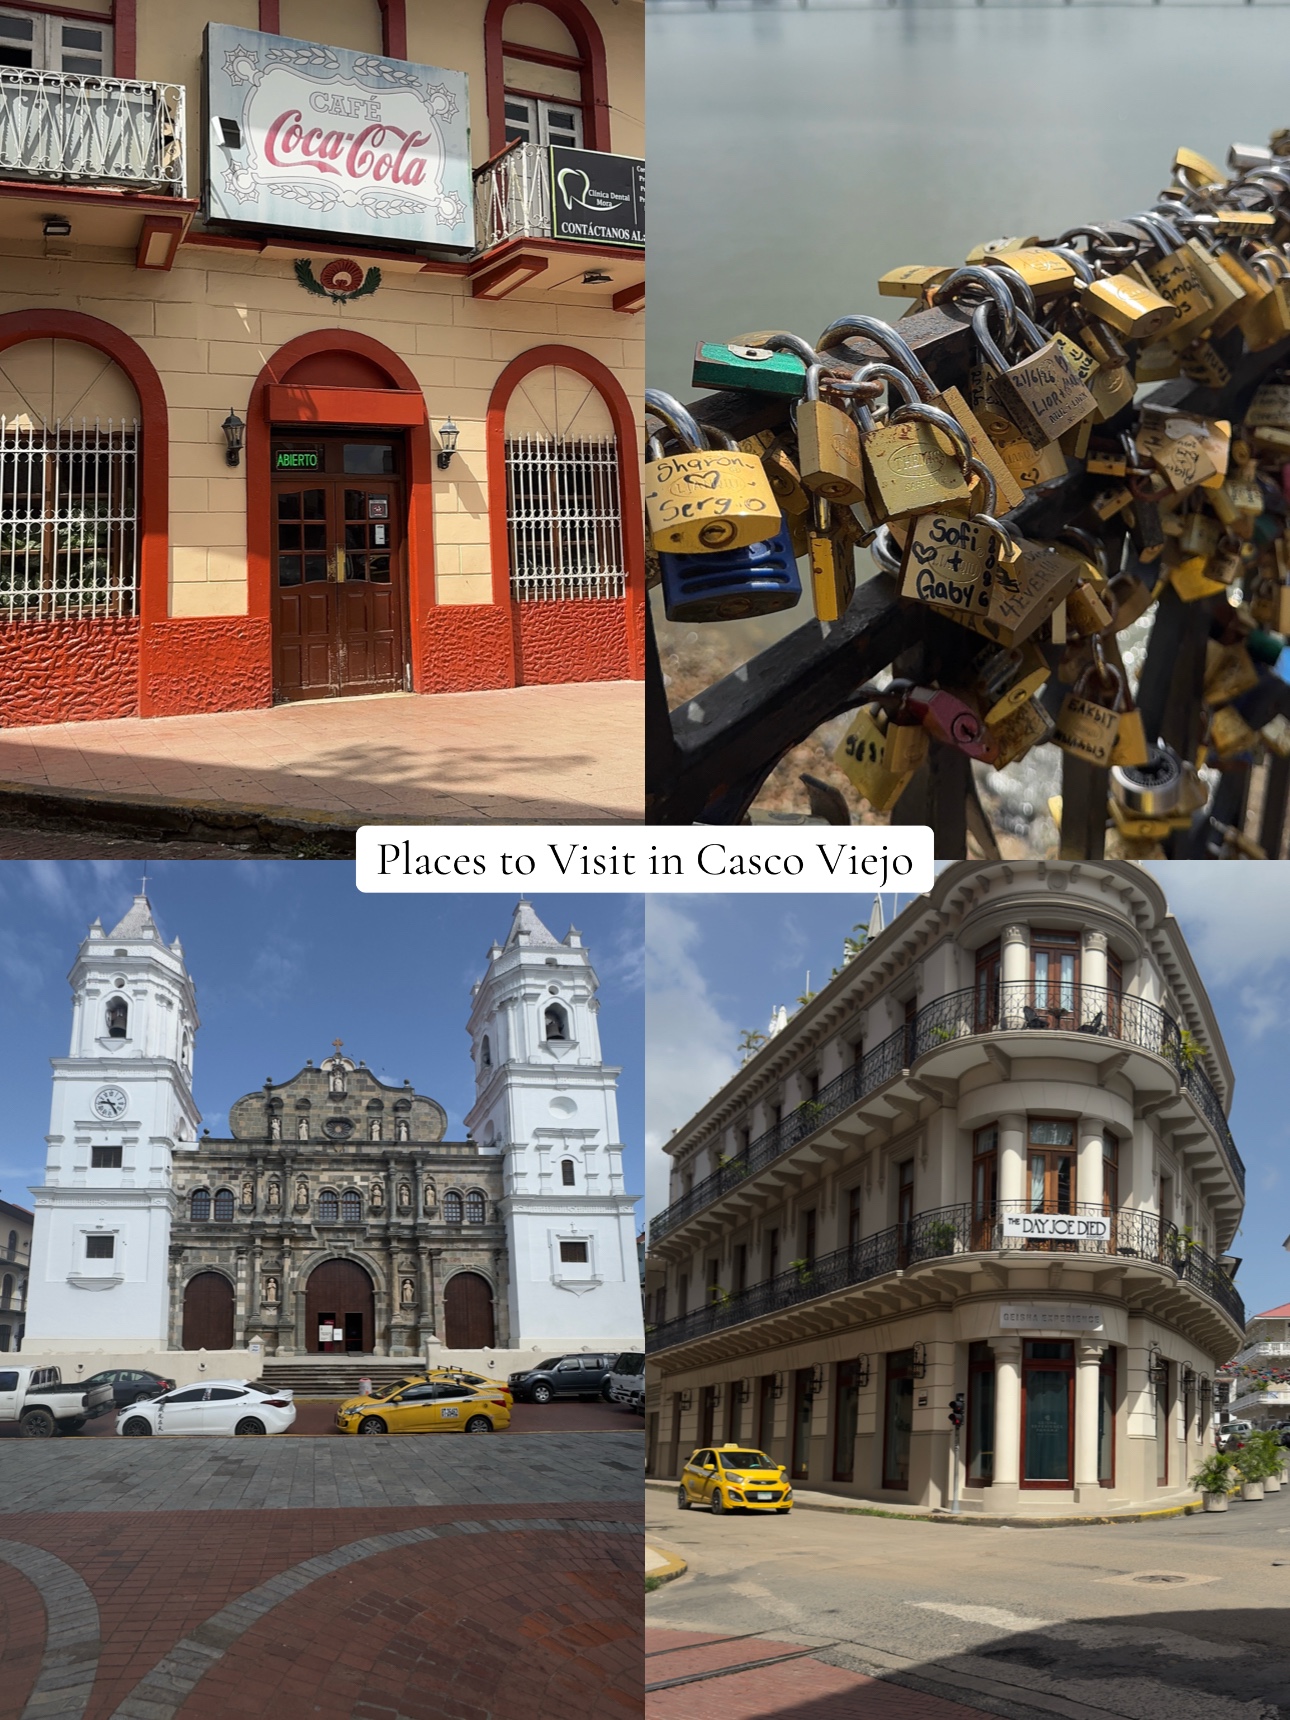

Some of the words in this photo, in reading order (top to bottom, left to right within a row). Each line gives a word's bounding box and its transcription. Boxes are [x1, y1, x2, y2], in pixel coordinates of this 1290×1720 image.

[309, 91, 382, 122] CAFÉ
[264, 109, 432, 187] Coca-Cola
[588, 189, 610, 199] Clínica
[610, 192, 631, 202] Dental
[596, 199, 613, 207] Mora
[561, 222, 630, 240] CONTÁCTANOS
[277, 453, 318, 467] ABIERTO
[657, 456, 744, 483] Sharon
[929, 518, 979, 551] Sofi
[916, 568, 974, 608] Gaby
[1007, 1217, 1021, 1226] THE
[1022, 1218, 1049, 1234] DAY
[1048, 1219, 1075, 1235] JOE
[1077, 1220, 1107, 1236] DIED
[1003, 1312, 1038, 1322] GEISHA
[1041, 1313, 1100, 1324] EXPERIENCE
